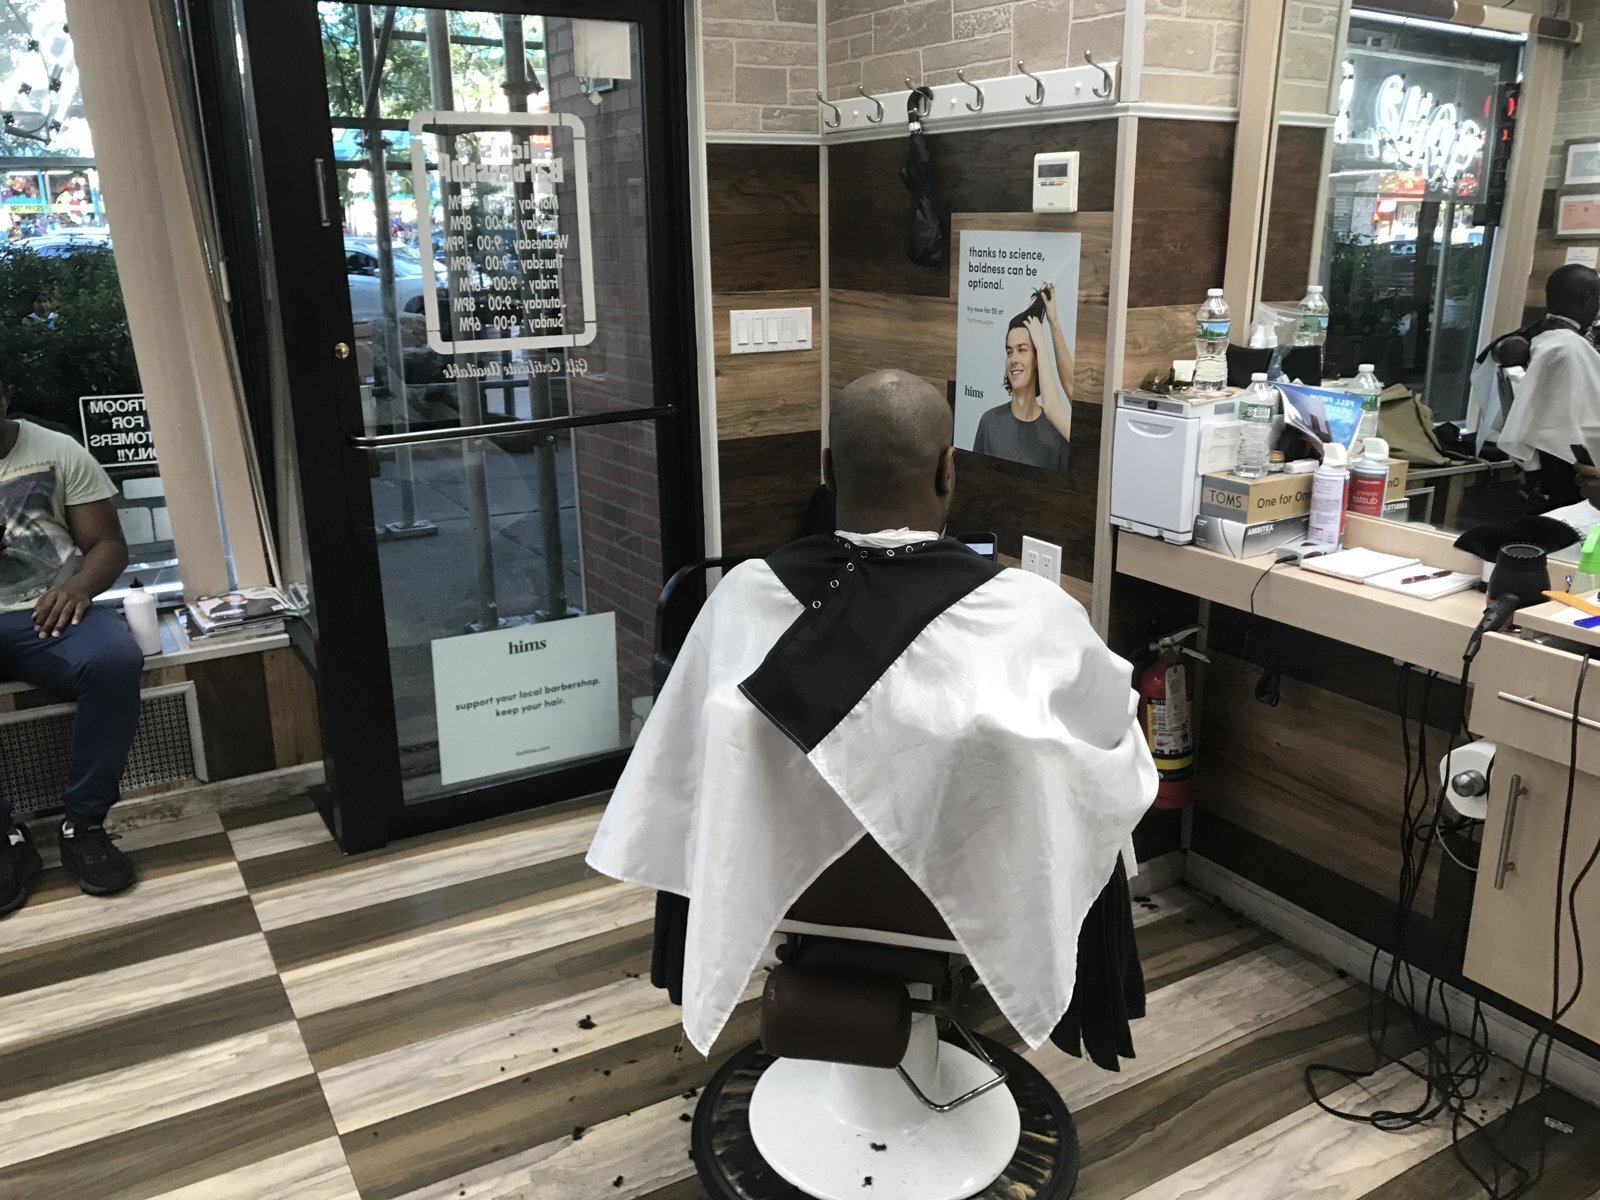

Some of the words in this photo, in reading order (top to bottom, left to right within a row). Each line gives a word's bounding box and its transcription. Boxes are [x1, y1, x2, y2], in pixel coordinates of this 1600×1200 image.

[969, 246, 996, 260] thanks
[998, 248, 1007, 259] to
[1009, 247, 1045, 262] science,
[968, 261, 1005, 275] baldness
[1007, 265, 1024, 276] can
[1025, 264, 1038, 277] be
[968, 277, 1004, 292] optional.
[964, 385, 985, 399] hims
[1210, 489, 1242, 509] TOMS
[1257, 497, 1277, 509] One
[1279, 493, 1292, 505] for
[508, 639, 547, 655] hims
[455, 697, 494, 711] support
[495, 692, 517, 705] your
[519, 687, 542, 699] local
[544, 677, 602, 695] barbershop.
[495, 706, 519, 718] keep
[521, 702, 542, 715] your
[544, 697, 566, 709] hair.
